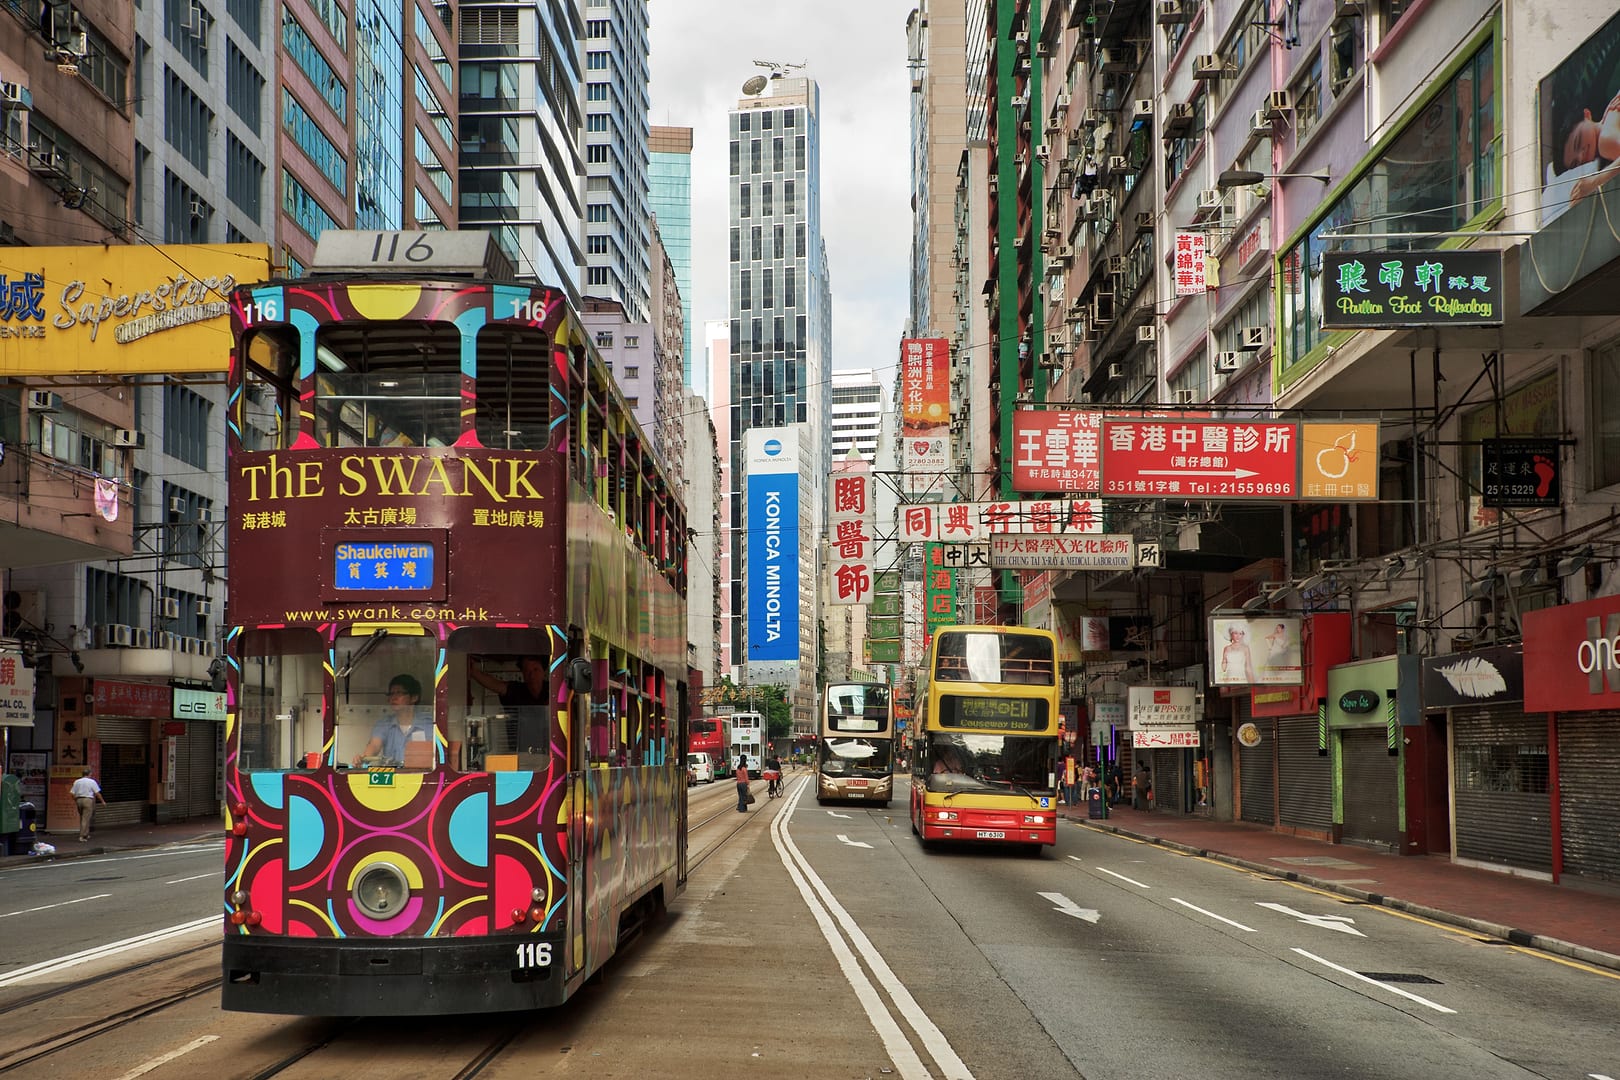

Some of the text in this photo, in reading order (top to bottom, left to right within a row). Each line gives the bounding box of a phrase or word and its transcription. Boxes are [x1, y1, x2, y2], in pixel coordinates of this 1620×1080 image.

[371, 233, 434, 262] 116
[1177, 235, 1193, 286] 黃錦華
[1193, 236, 1204, 285] 跌打骨科
[1336, 259, 1444, 294] 聽雨軒
[53, 272, 235, 342] Superstore
[244, 301, 277, 324] 116
[510, 298, 547, 322] 116
[1388, 295, 1422, 314] Foot
[1428, 295, 1493, 317] Reflexology
[0, 326, 46, 339] ENTRE
[1017, 428, 1099, 468] 王雪華
[1109, 425, 1291, 453] 香港中醫診所
[1170, 456, 1229, 468] (灣仔總館)
[339, 455, 544, 502] SWANK
[1057, 480, 1085, 490] TEL:
[1108, 481, 1181, 492] 351號1字樓
[1308, 484, 1369, 497] 註冊中醫
[1511, 485, 1535, 495] 5229
[241, 511, 287, 530] 海港城
[344, 507, 417, 525] 太古廣場
[472, 509, 545, 528] 置地廣場
[336, 545, 428, 560] Shaukeiwan
[995, 556, 1006, 565] THE
[1008, 556, 1029, 565] CHUNG
[1031, 556, 1040, 565] TAI
[1066, 556, 1090, 566] MEDICAL
[1093, 556, 1129, 566] LABORATORY
[766, 491, 781, 642] KONICA MINOLTA
[286, 606, 488, 621] www.swank.com.hk
[960, 719, 1029, 729] Causeway Bay
[371, 773, 391, 784] C 7
[516, 943, 552, 968] 116
